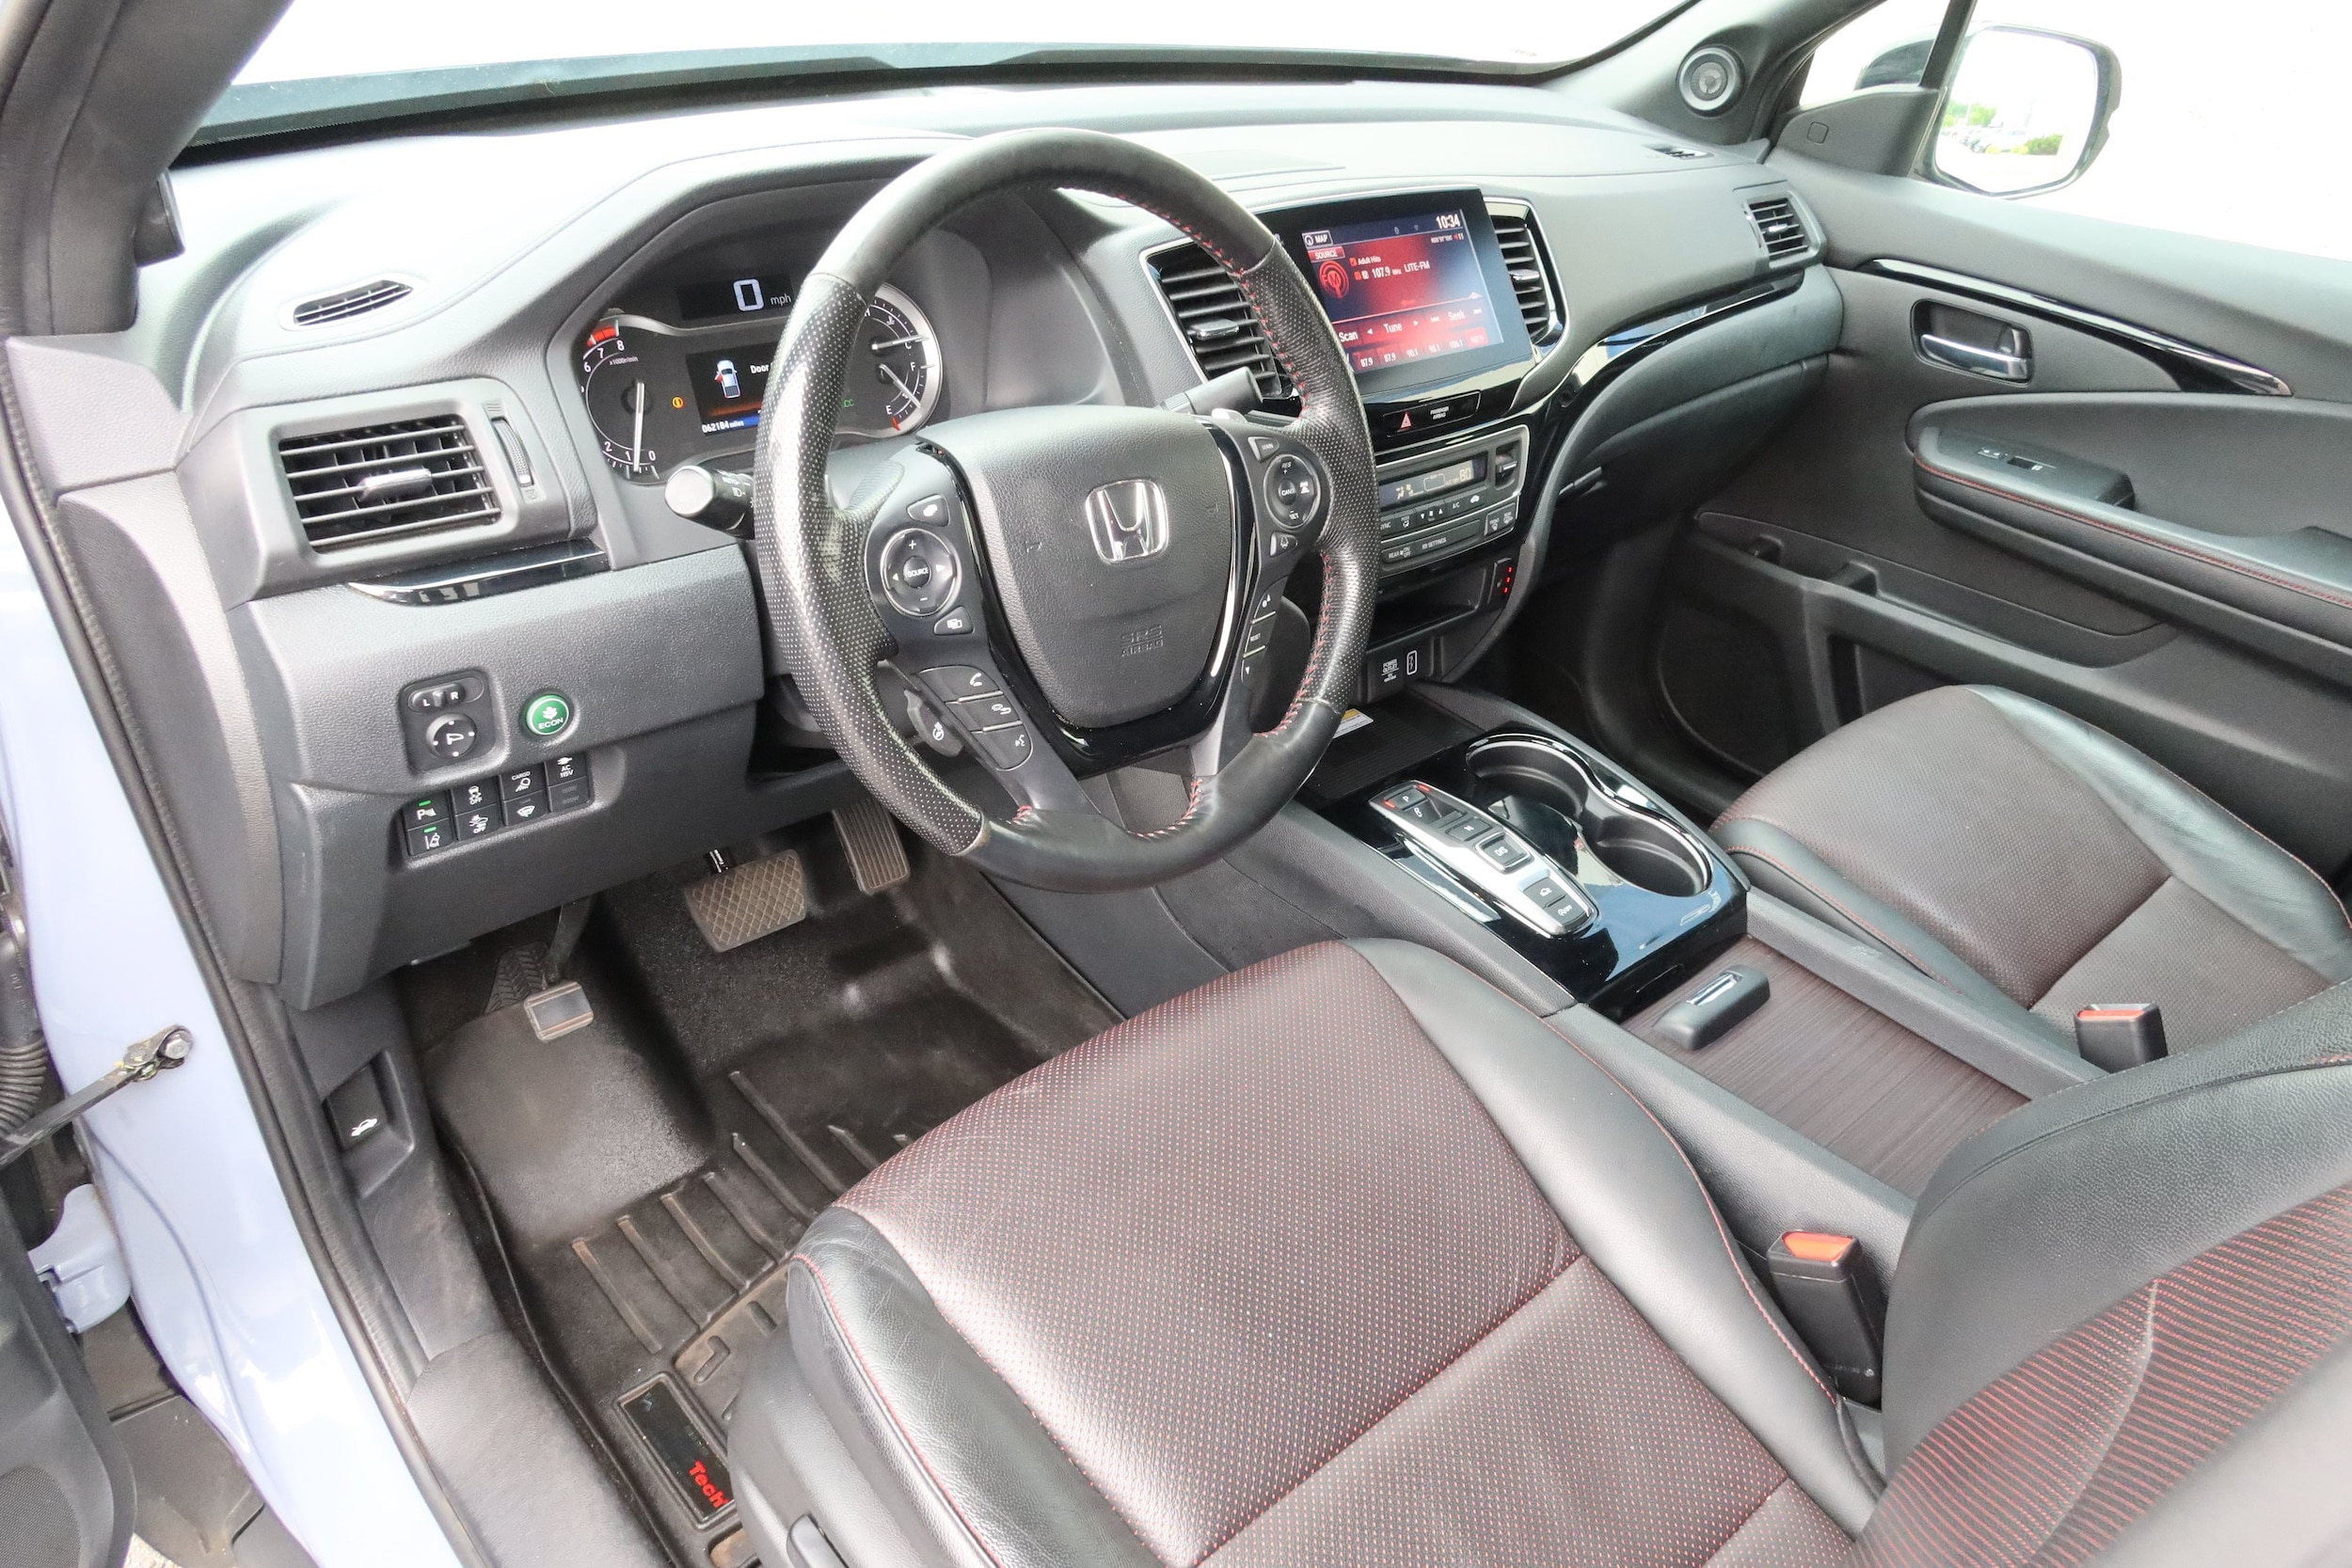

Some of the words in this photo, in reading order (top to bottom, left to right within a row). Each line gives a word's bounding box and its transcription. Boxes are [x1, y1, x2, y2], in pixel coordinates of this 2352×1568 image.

[1436, 214, 1461, 230] 10:34
[1314, 234, 1328, 243] MAP
[1314, 249, 1338, 260] SOURCE
[1358, 257, 1372, 265] Adult
[1371, 255, 1382, 264] Hits
[1372, 266, 1391, 278] 107.9
[1404, 260, 1431, 273] LITE-FM
[733, 278, 764, 311] 0
[770, 293, 792, 307] mph
[1338, 331, 1359, 342] Scan
[1383, 323, 1403, 334] Tune
[1447, 309, 1467, 321] Seek
[616, 340, 625, 351] 8
[596, 347, 604, 358] 7
[1360, 356, 1374, 368] 87.9
[1383, 352, 1396, 363] 87.9
[583, 361, 592, 372] 6
[750, 364, 770, 374] Door
[910, 361, 916, 372] F
[885, 404, 893, 415] E
[701, 420, 729, 433] 062184
[604, 440, 612, 452] 2
[625, 451, 631, 461] 1
[647, 450, 657, 462] 0
[1459, 467, 1472, 483] 80
[907, 566, 929, 578] SOURCE
[1121, 624, 1163, 643] SRS
[1121, 639, 1164, 657] AIRBAG
[422, 699, 430, 707] L
[450, 691, 459, 701] R
[538, 717, 564, 730] ECON
[561, 764, 571, 772] AC
[511, 771, 531, 781] CARGO
[560, 769, 574, 779] 115V
[469, 796, 483, 805] OFF
[1414, 807, 1422, 818] R
[689, 1460, 727, 1509] Tech
